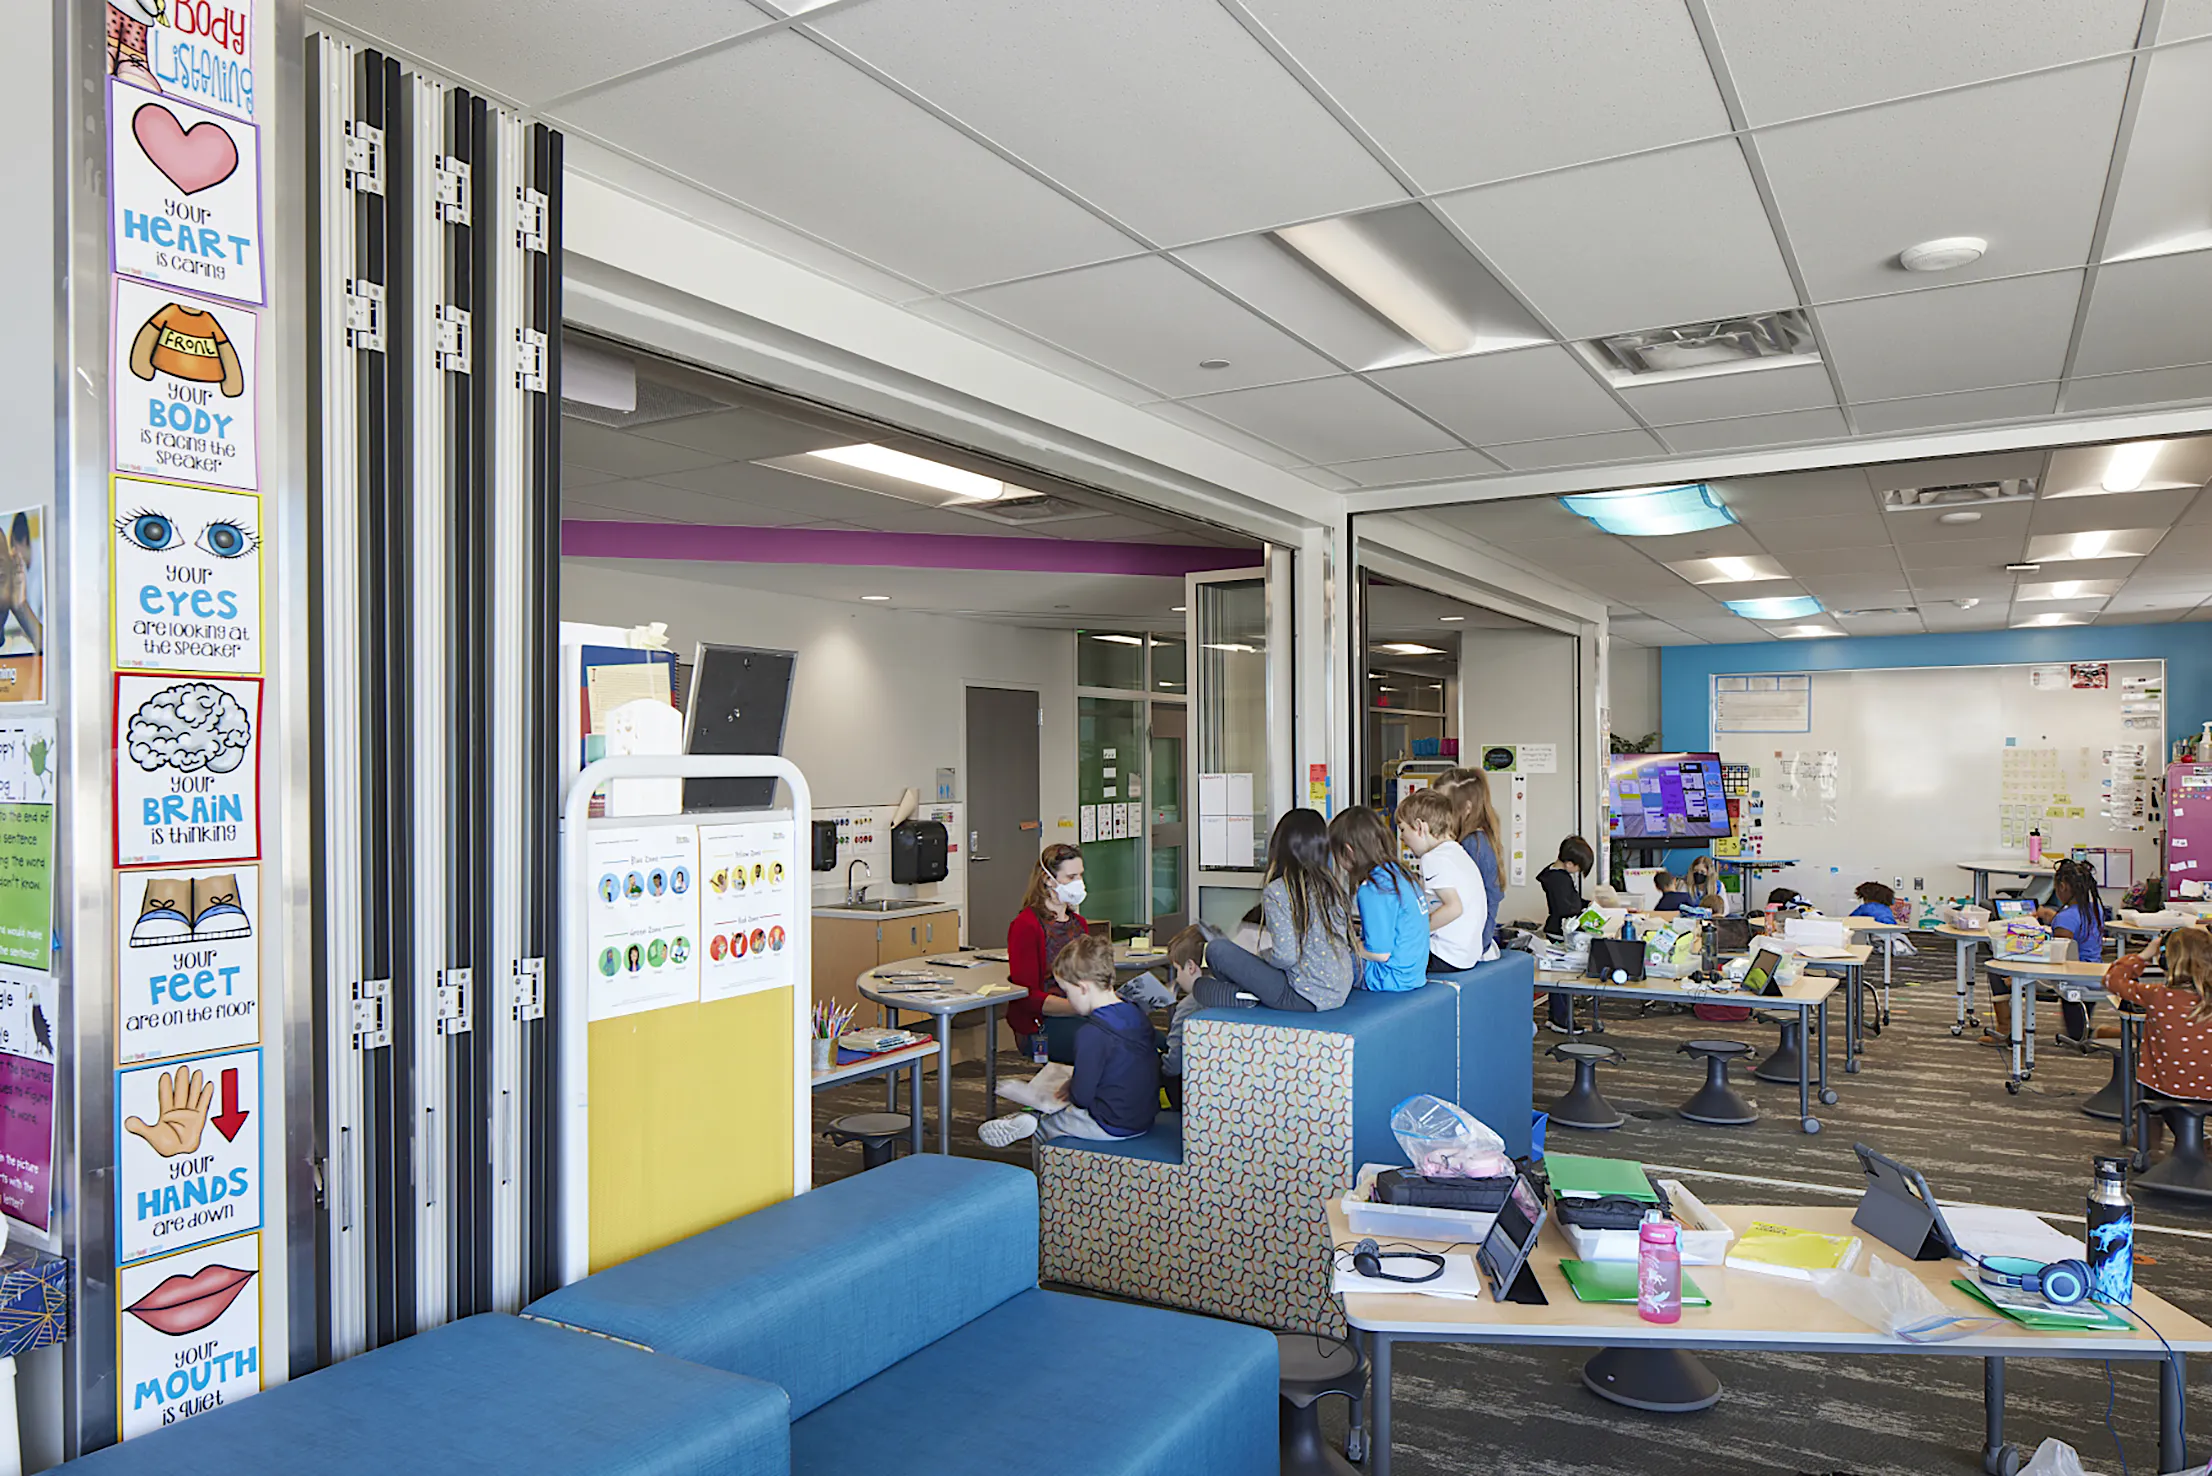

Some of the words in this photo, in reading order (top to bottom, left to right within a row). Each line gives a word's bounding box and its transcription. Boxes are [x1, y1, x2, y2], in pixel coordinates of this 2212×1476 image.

[155, 30, 253, 115] Listening
[165, 198, 211, 225] your
[156, 251, 168, 267] is
[171, 256, 226, 280] caring
[168, 382, 213, 406] your
[149, 398, 233, 439] BODY
[140, 428, 152, 444] is
[156, 431, 206, 452] facing
[210, 441, 236, 458] the
[156, 450, 222, 473] speaker
[166, 564, 213, 585] your
[133, 620, 166, 636] are
[169, 621, 226, 640] looking
[229, 626, 250, 641] at
[144, 639, 171, 655] the
[174, 640, 241, 658] speaker
[171, 776, 214, 793] your
[151, 827, 164, 845] is
[169, 824, 236, 844] thinking
[173, 949, 217, 970] your
[126, 1013, 159, 1031] are
[162, 1010, 183, 1027] on
[187, 1006, 212, 1023] the
[216, 1001, 255, 1019] floor
[170, 1155, 214, 1180] your
[137, 1167, 248, 1221] HANDS
[152, 1216, 185, 1237] are
[188, 1203, 234, 1229] down
[175, 1340, 218, 1368] your
[134, 1346, 257, 1410] MOUTH
[162, 1407, 175, 1426] is
[179, 1390, 224, 1418] quiet
